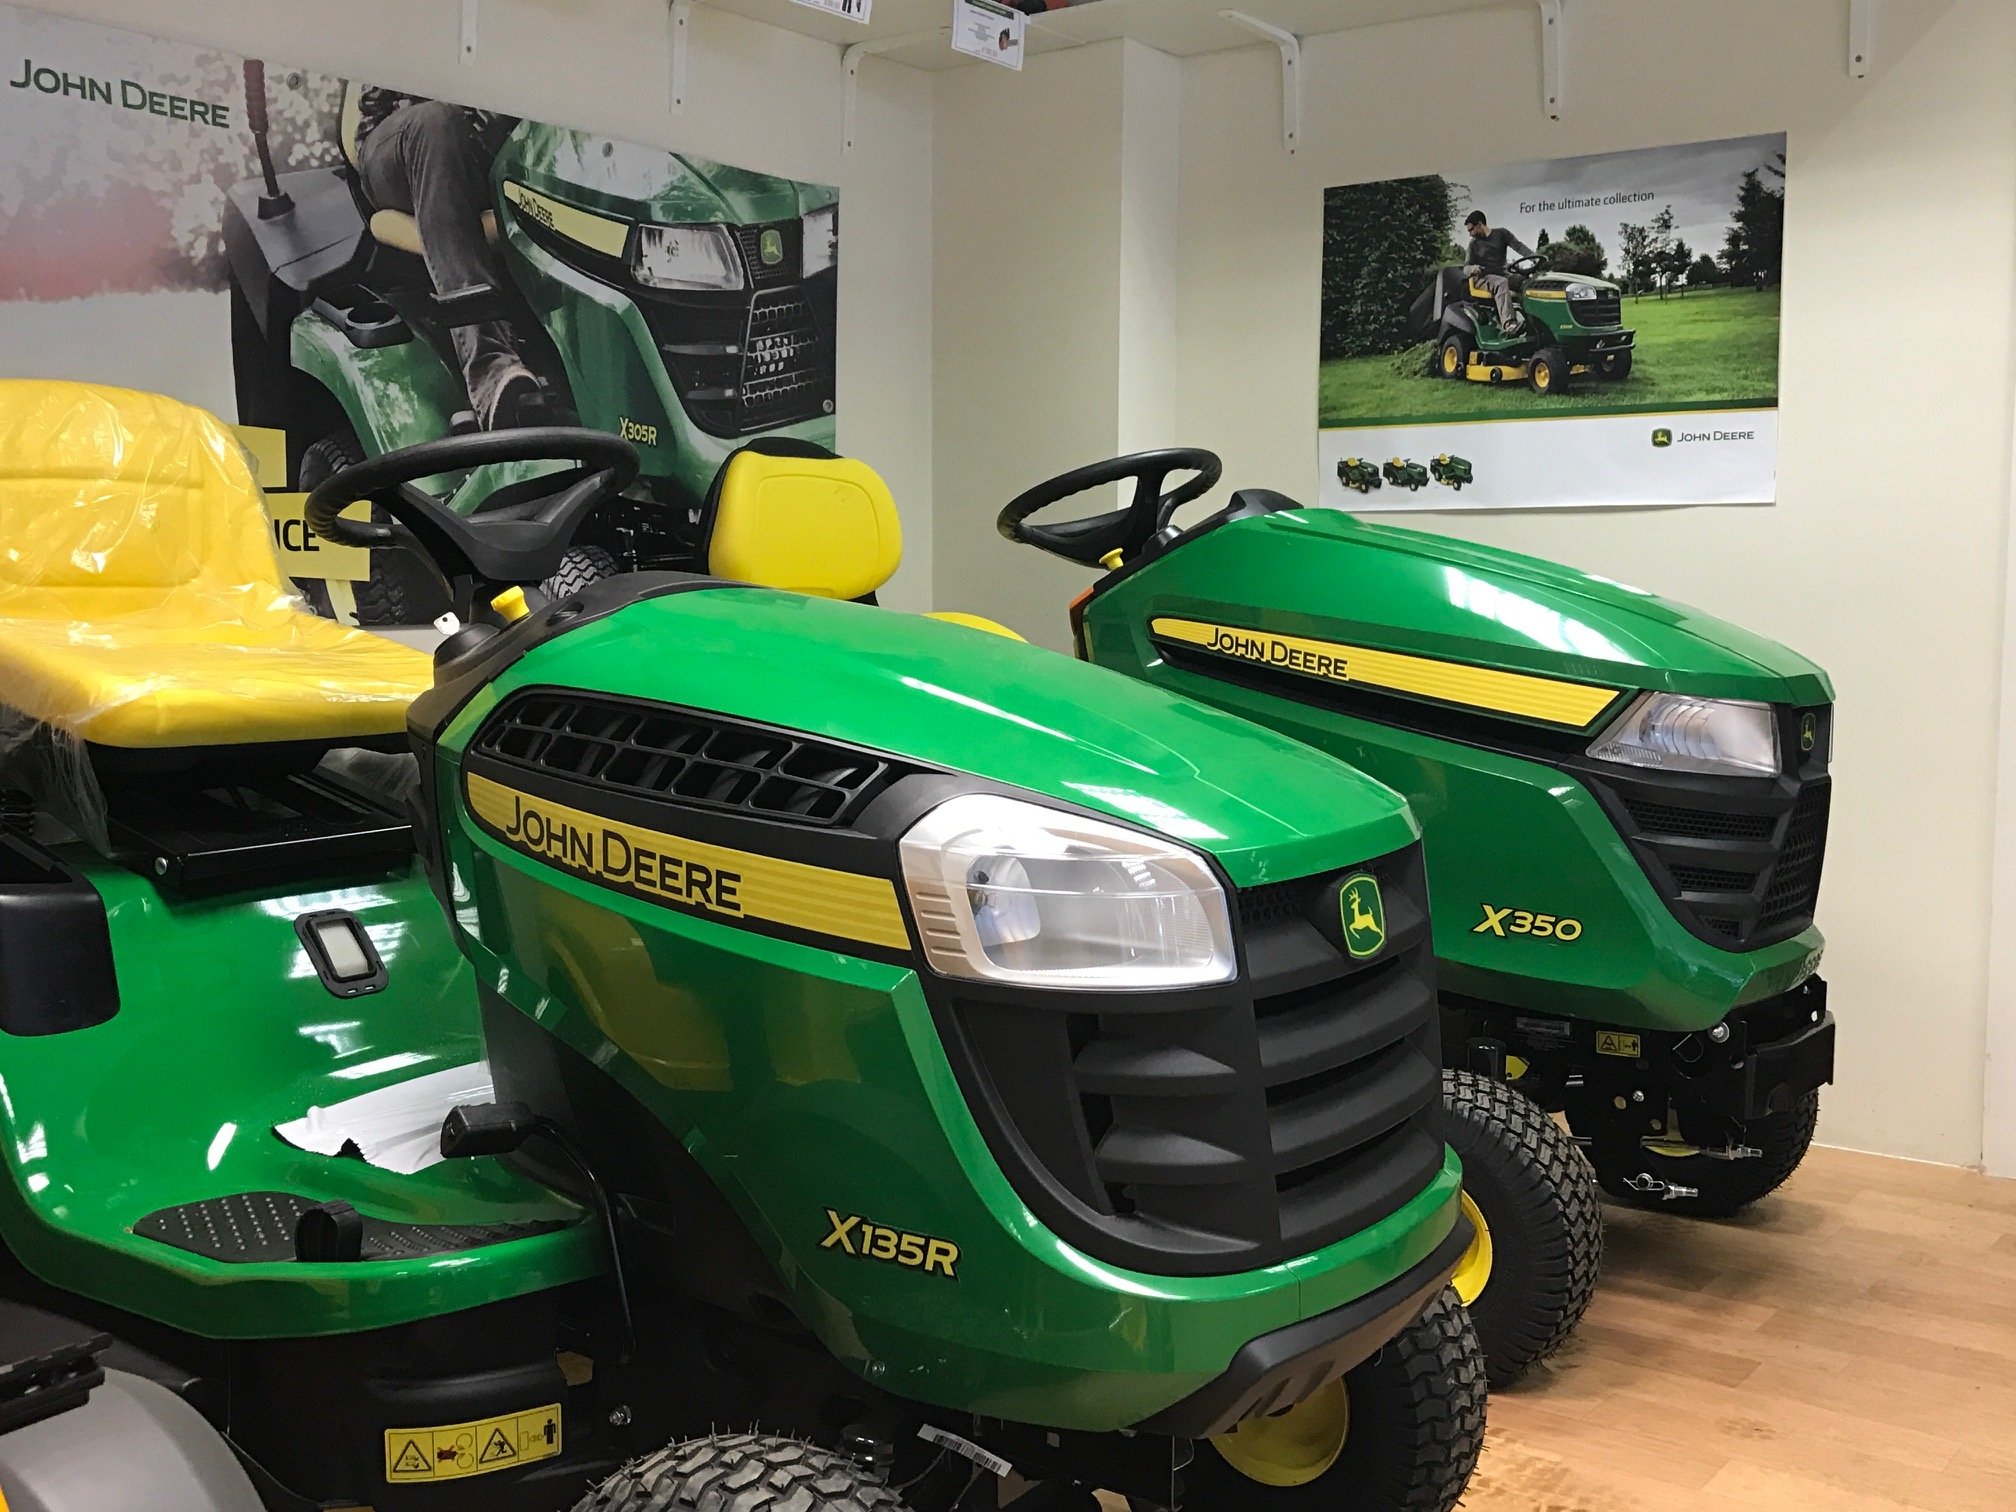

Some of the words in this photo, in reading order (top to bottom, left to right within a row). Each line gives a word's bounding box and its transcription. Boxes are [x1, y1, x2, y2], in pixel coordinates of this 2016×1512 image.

[10, 58, 113, 105] JOHN
[120, 79, 230, 129] DEERE
[1519, 202, 1535, 214] For
[1538, 201, 1555, 212] the
[1558, 197, 1601, 210] ultimate
[1603, 191, 1655, 206] collection
[619, 416, 657, 446] X305R
[1677, 432, 1711, 442] JOHN
[1713, 430, 1755, 441] DEERE
[1206, 627, 1265, 660] JOHN
[1270, 640, 1348, 678] DEERE
[505, 795, 594, 868] JOHN
[602, 828, 742, 912] DEERE
[1472, 903, 1583, 941] X350
[820, 1208, 959, 1277] X135R
